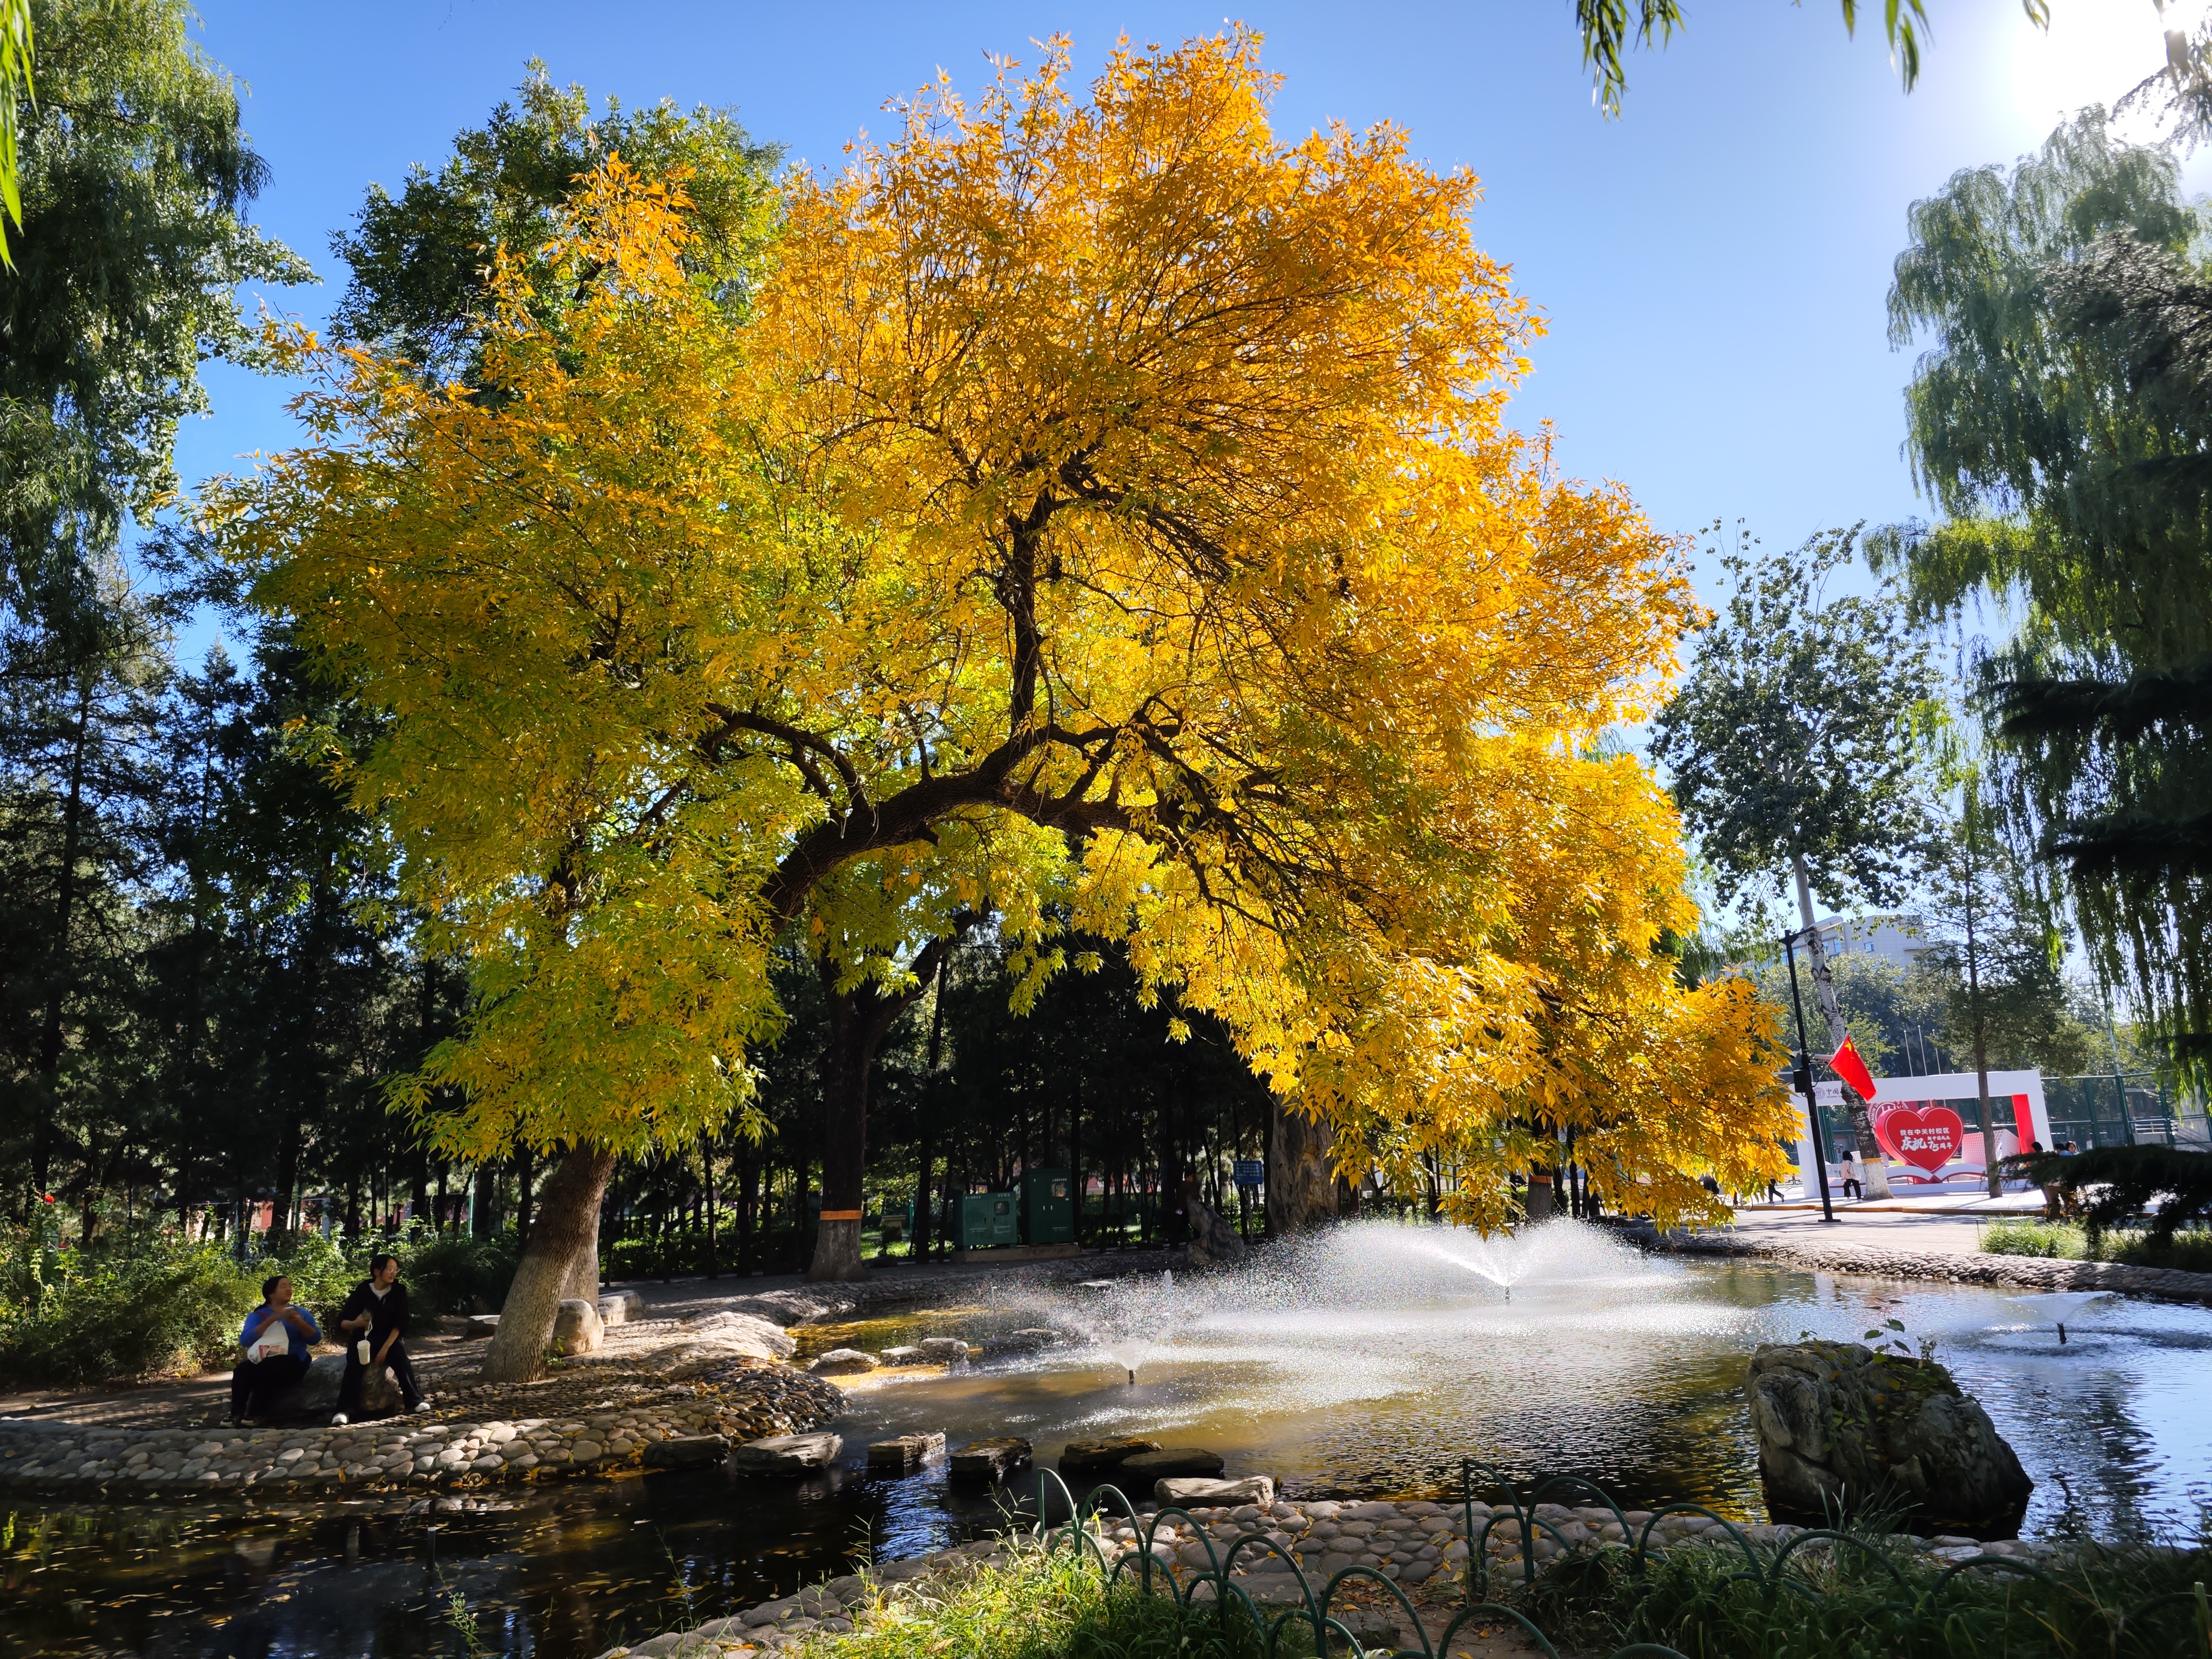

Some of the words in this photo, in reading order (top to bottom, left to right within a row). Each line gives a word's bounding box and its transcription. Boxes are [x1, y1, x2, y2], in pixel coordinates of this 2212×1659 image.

[1900, 1127, 1950, 1136] 我在中关村校区
[1901, 1136, 1927, 1151] 庆祝
[1927, 1141, 1953, 1151] 75周年
